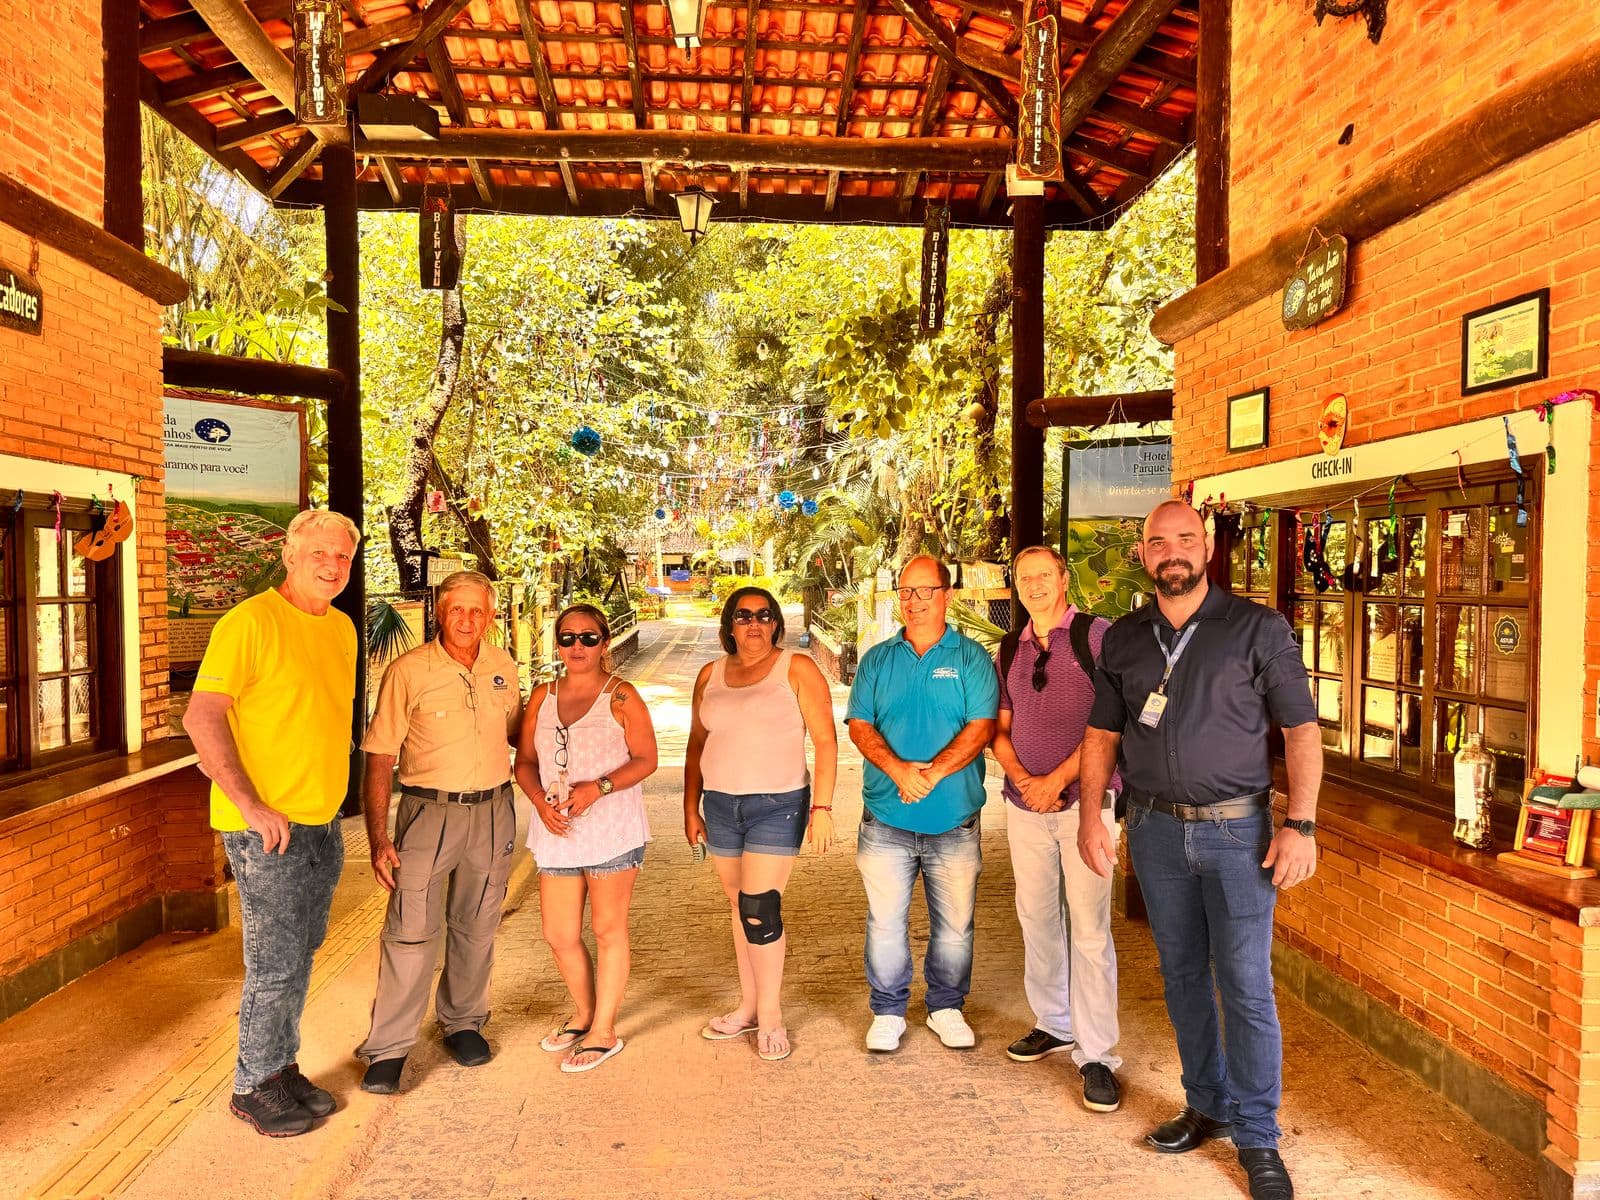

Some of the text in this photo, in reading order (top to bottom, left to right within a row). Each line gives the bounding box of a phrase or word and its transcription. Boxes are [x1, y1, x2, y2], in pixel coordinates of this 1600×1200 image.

[1143, 451, 1170, 462] Hotel
[200, 463, 221, 473] para
[223, 464, 249, 474] você!
[1133, 463, 1165, 476] Parque
[1311, 456, 1352, 479] CHECK-IN
